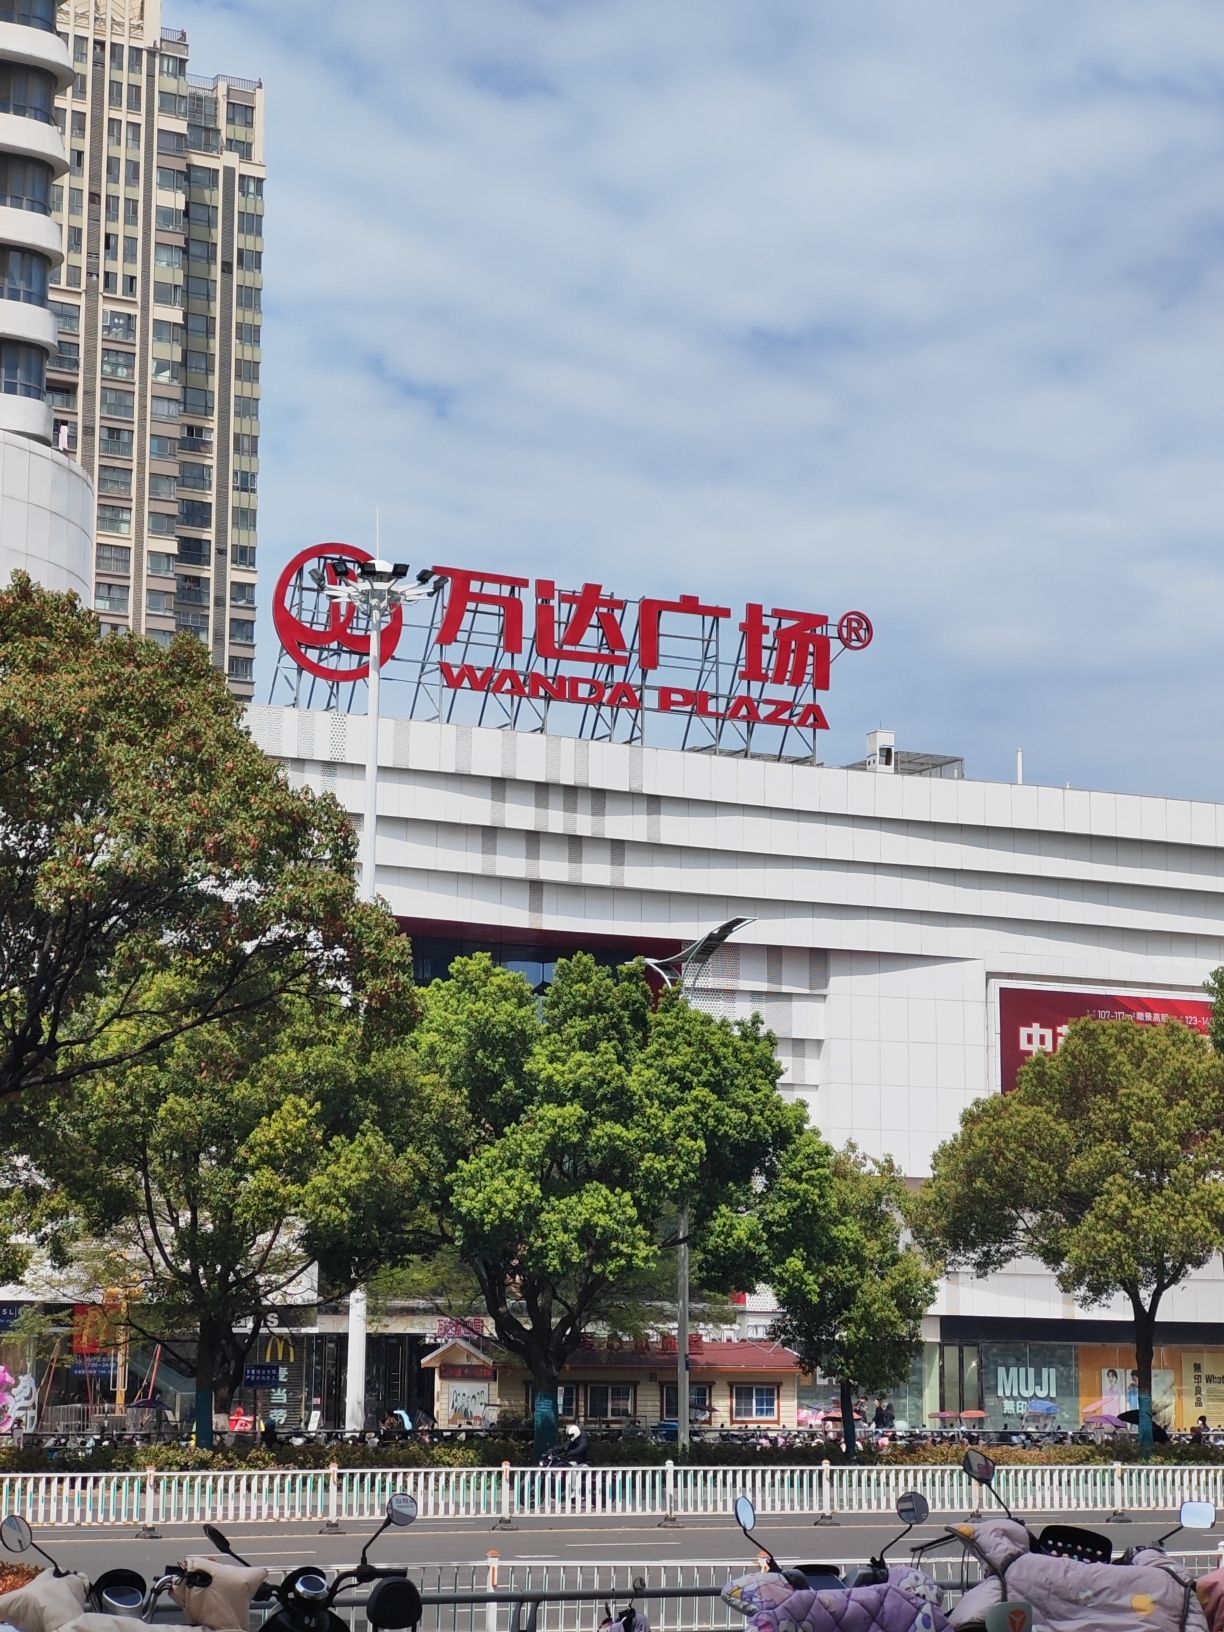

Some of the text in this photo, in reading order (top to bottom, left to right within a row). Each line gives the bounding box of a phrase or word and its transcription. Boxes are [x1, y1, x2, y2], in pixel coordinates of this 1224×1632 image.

[432, 565, 829, 690] 万达广场
[438, 661, 830, 730] WANDA PLAZA
[997, 1366, 1057, 1397] MUJI
[1193, 1363, 1203, 1407] 無印良品
